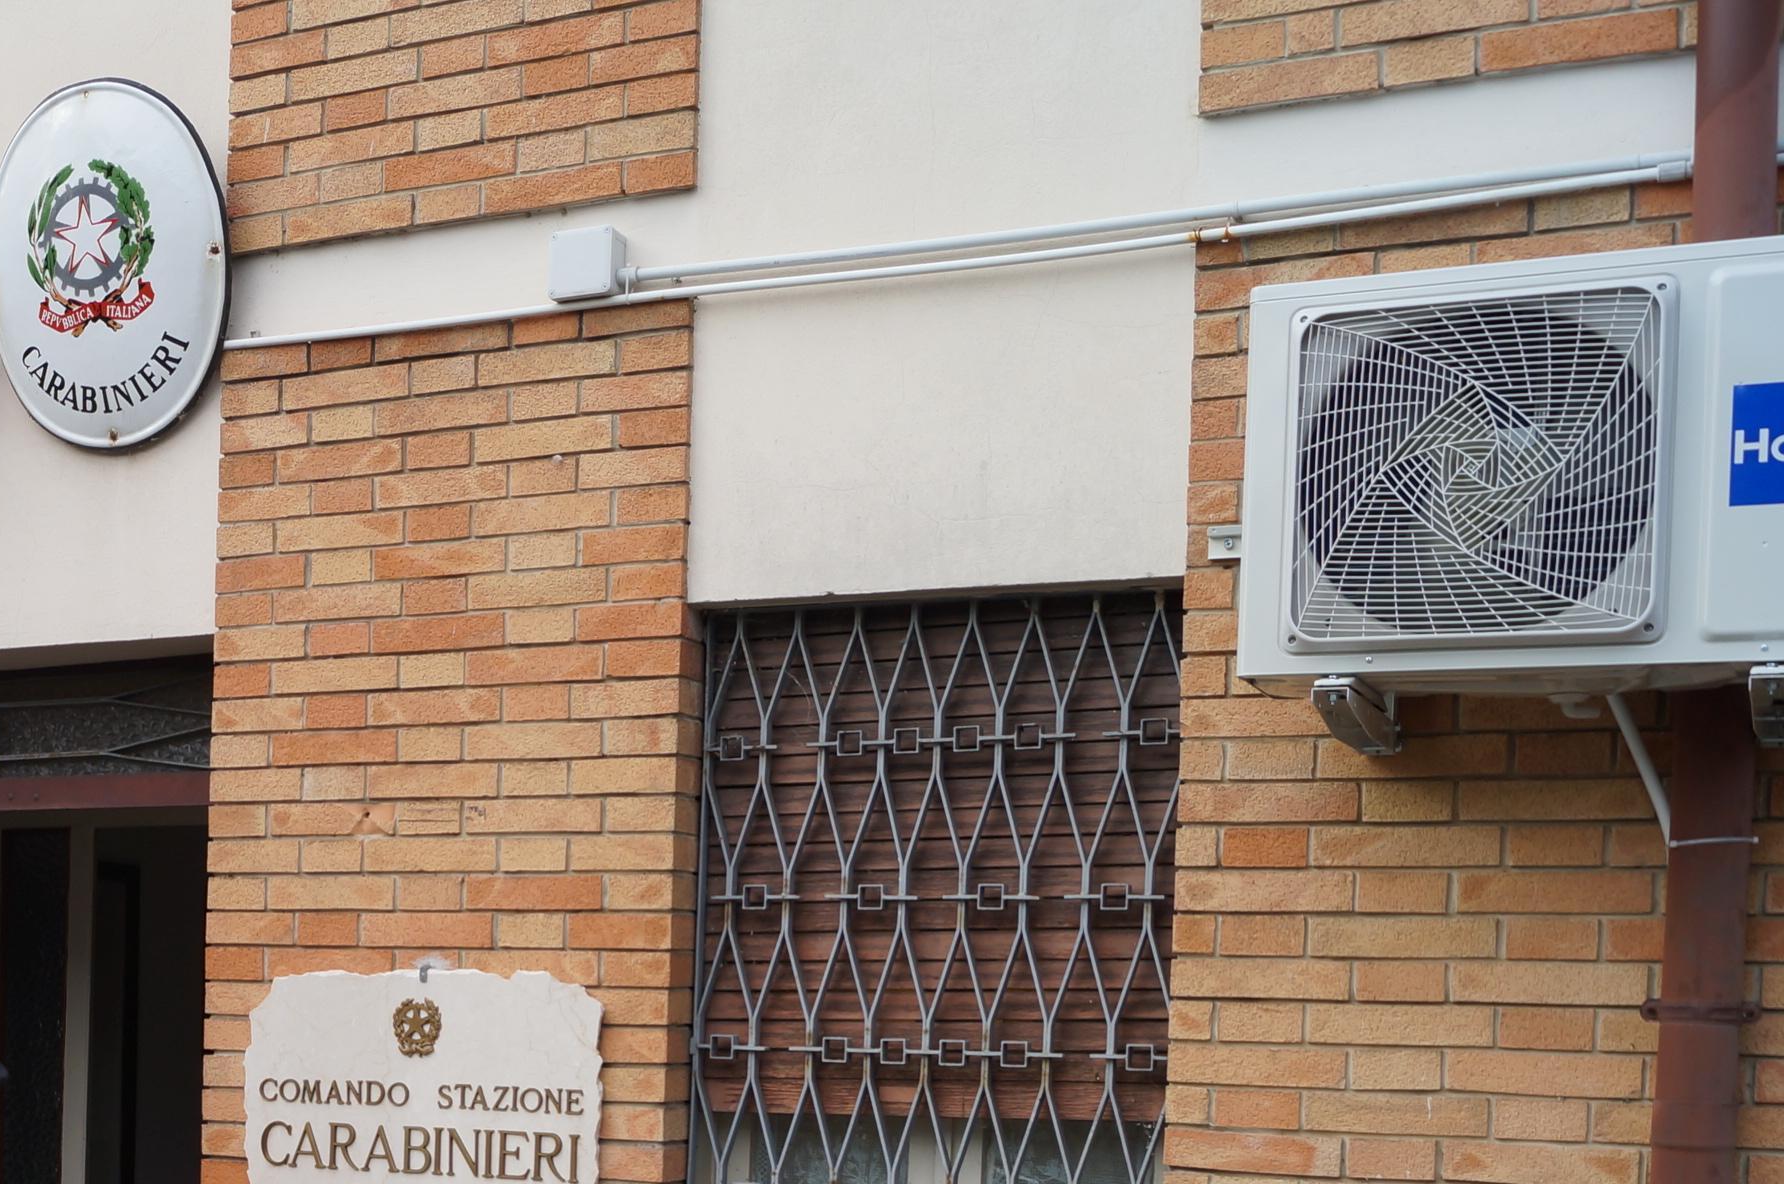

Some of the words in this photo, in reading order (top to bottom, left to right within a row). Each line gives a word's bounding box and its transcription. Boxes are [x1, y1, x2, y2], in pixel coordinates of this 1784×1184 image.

[106, 294, 151, 318] ITALIANA
[22, 331, 190, 413] CARABINIERI
[259, 1078, 410, 1107] COMANDO
[437, 1084, 584, 1115] STAZIONE
[260, 1120, 580, 1184] CARABINIERI
